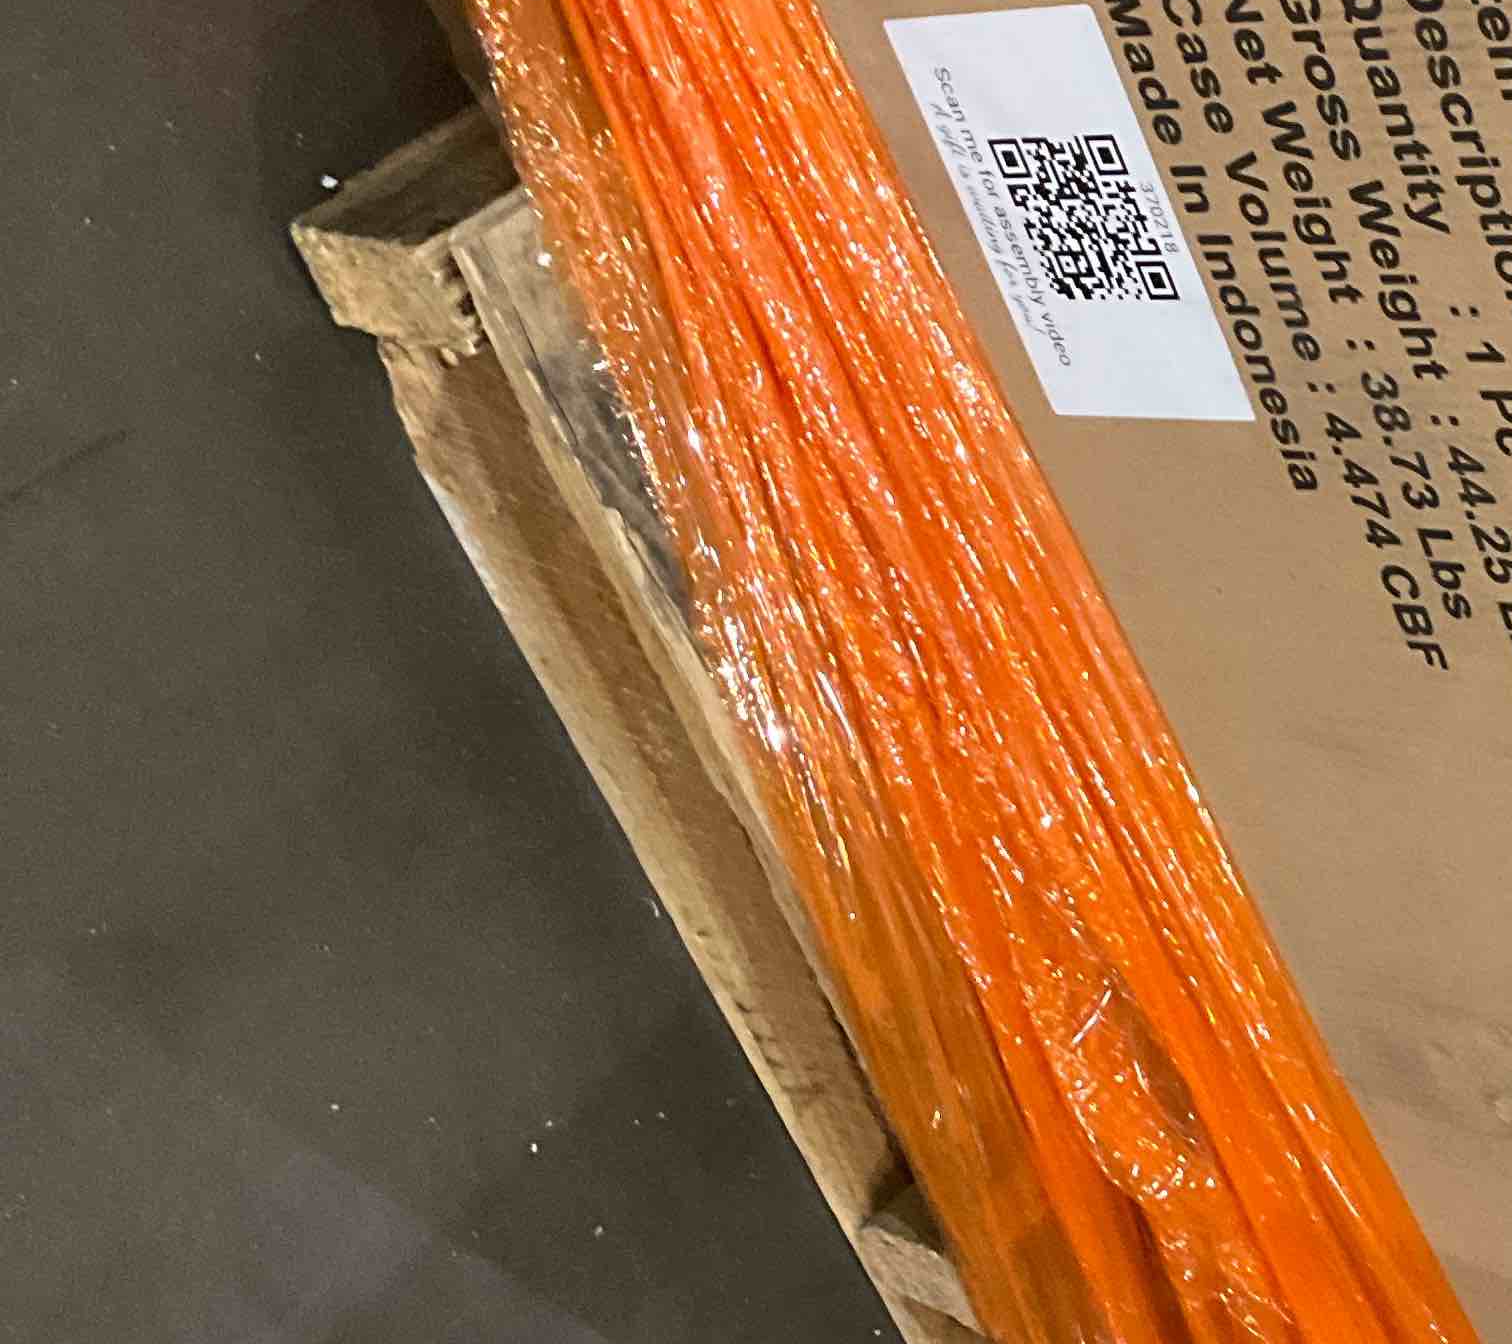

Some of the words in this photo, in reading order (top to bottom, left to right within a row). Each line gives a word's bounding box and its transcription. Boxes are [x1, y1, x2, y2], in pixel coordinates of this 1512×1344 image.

[934, 65, 966, 124] Scan
[960, 127, 984, 164] me
[977, 165, 1000, 200] for
[994, 205, 1046, 306] assembly
[1040, 311, 1072, 367] video
[1139, 183, 1180, 254] 370218
[1169, 164, 1210, 215] In
[1196, 233, 1318, 492] Indonesia
[1261, 100, 1365, 304] Weight
[1360, 370, 1440, 510] 38.73
[1416, 527, 1472, 620] Lbs
[1348, 179, 1449, 381] Weight
[1465, 341, 1506, 363] 1
[1225, 151, 1321, 362] Volume
[1324, 411, 1403, 549] 4.474
[1380, 564, 1449, 672] CBF
